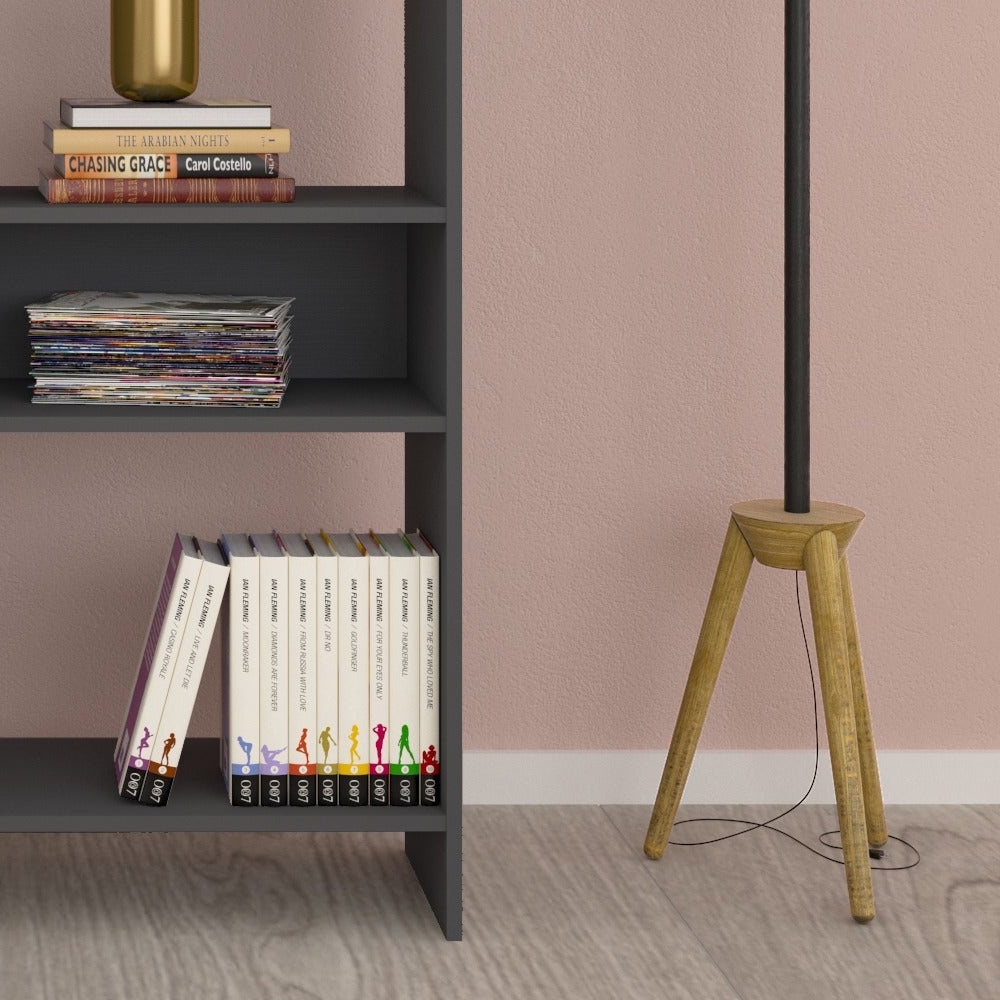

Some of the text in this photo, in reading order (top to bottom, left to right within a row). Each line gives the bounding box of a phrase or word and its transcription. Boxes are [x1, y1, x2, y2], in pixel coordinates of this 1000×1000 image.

[116, 135, 230, 147] THE ARABIAN NIGHTS
[69, 156, 171, 173] CHASING GRACE
[185, 157, 252, 171] Carol Costello
[182, 578, 191, 591] IAN
[206, 584, 215, 598] IAN
[174, 591, 188, 622] FLEMING
[198, 596, 211, 628] FLEMING
[167, 629, 177, 654] CASINO
[325, 631, 331, 641] DR
[325, 642, 331, 652] NO
[159, 654, 170, 680] ROYALE
[188, 650, 197, 665] AND
[184, 664, 193, 679] LET
[182, 678, 190, 689] DIE
[427, 701, 433, 710] ME
[126, 772, 141, 797] 007
[150, 780, 164, 803] 007
[240, 780, 251, 803] 007
[269, 780, 280, 803] 007
[298, 780, 309, 803] 007
[323, 780, 333, 803] 007
[349, 780, 360, 803] 007
[374, 779, 385, 802] 007
[400, 780, 410, 803] 007
[425, 779, 436, 802] 007
